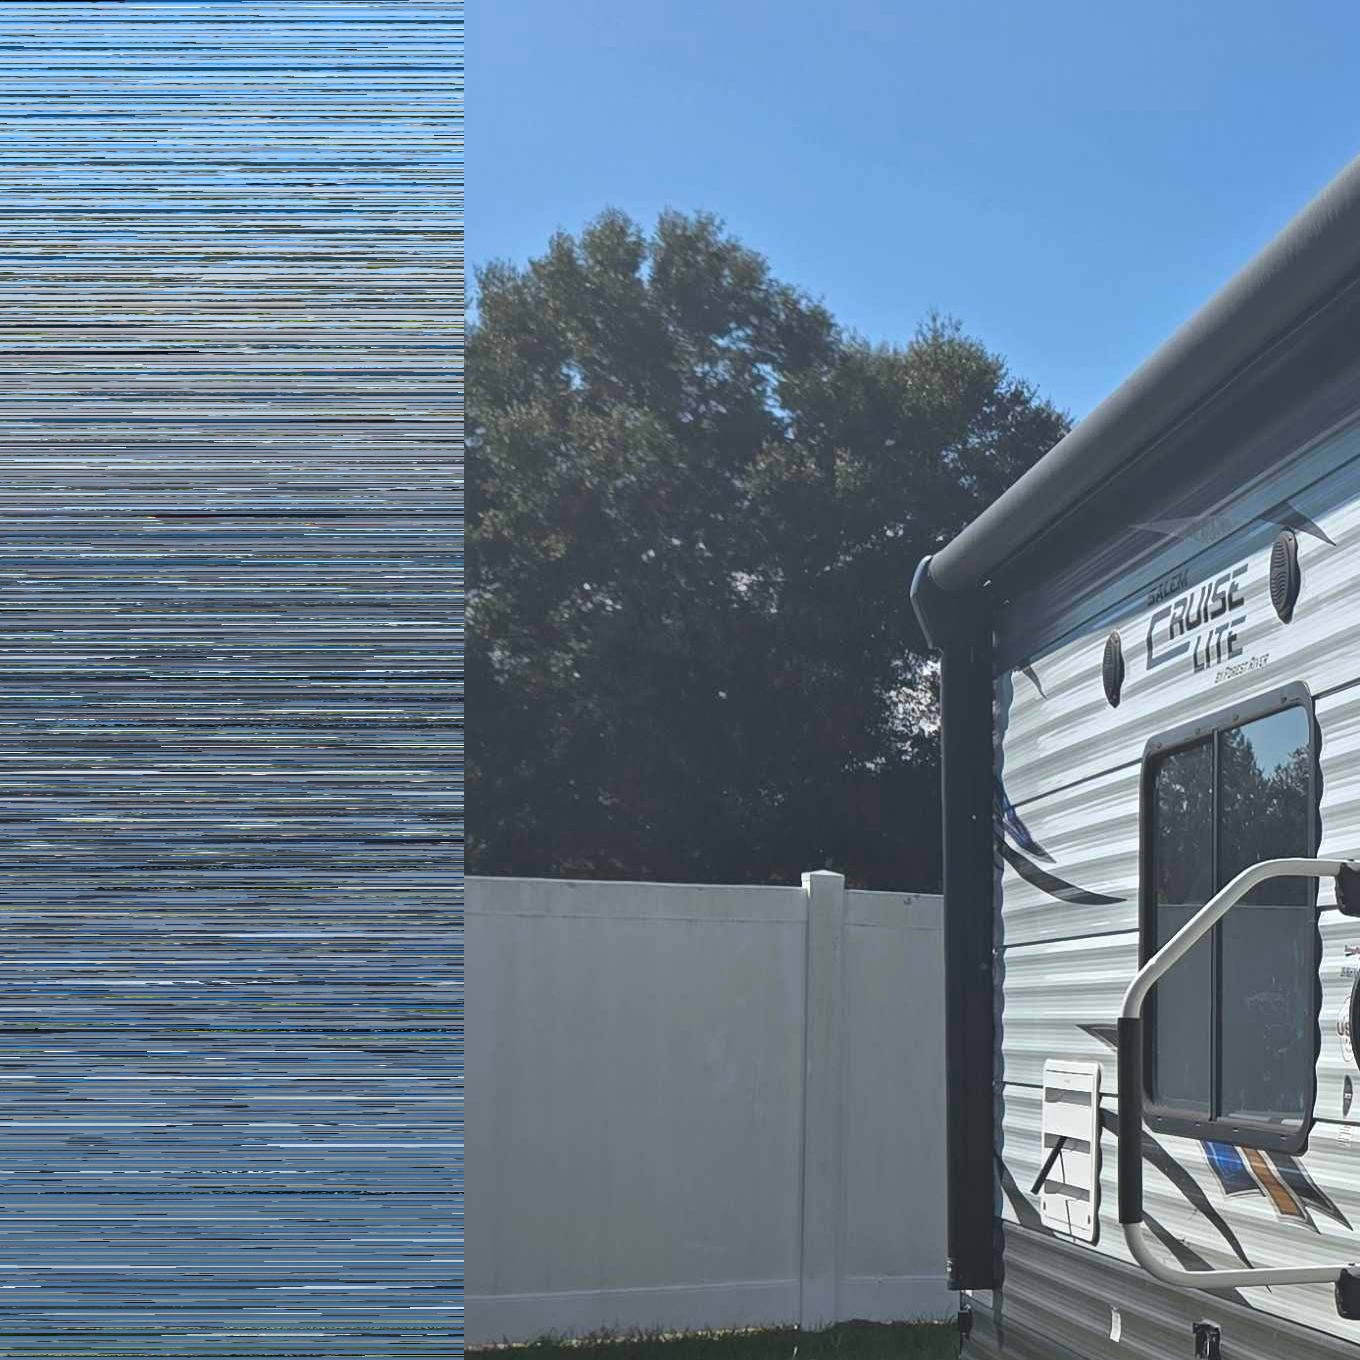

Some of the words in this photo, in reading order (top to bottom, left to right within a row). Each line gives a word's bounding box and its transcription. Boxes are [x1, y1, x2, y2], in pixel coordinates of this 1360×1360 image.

[1147, 567, 1189, 606] SALEM
[1146, 563, 1249, 671] CRUISE
[1193, 615, 1247, 674] LITE
